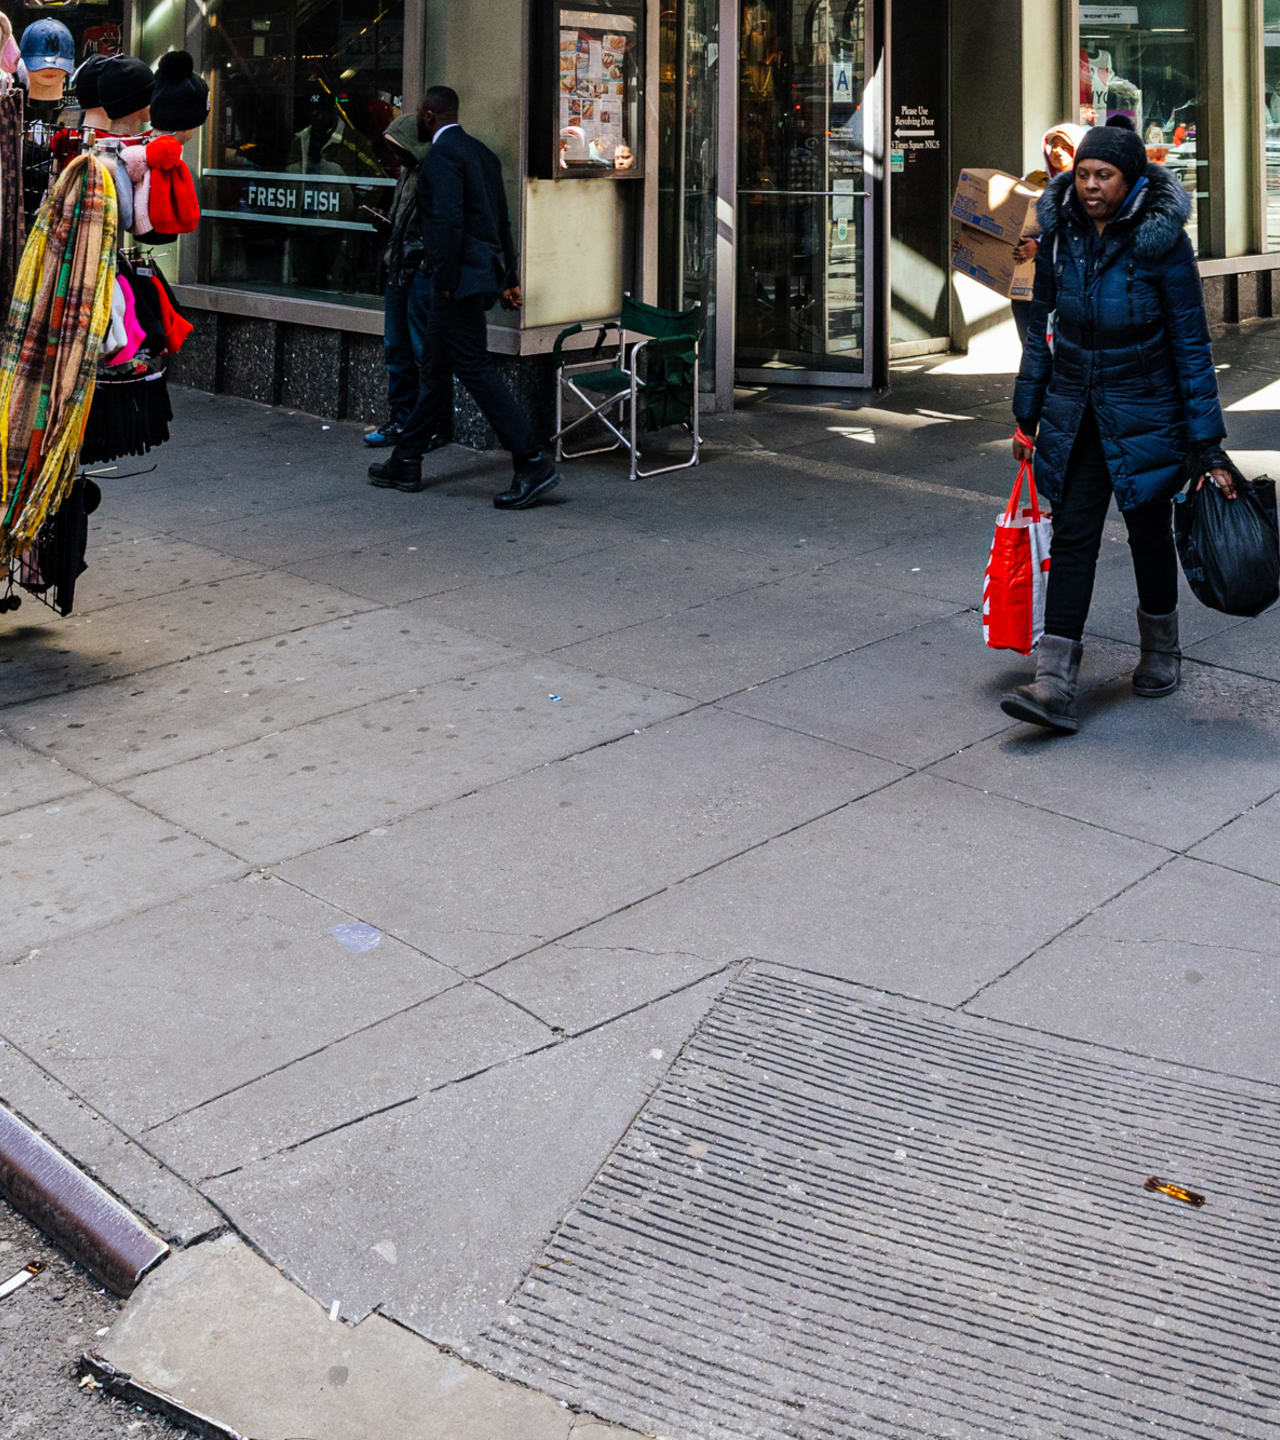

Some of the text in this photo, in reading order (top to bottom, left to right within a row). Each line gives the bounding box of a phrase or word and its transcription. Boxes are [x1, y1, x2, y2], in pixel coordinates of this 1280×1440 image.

[836, 70, 849, 91] A
[901, 106, 929, 116] Please Use
[921, 117, 935, 126] Door
[248, 187, 341, 213] FRESH FISH
